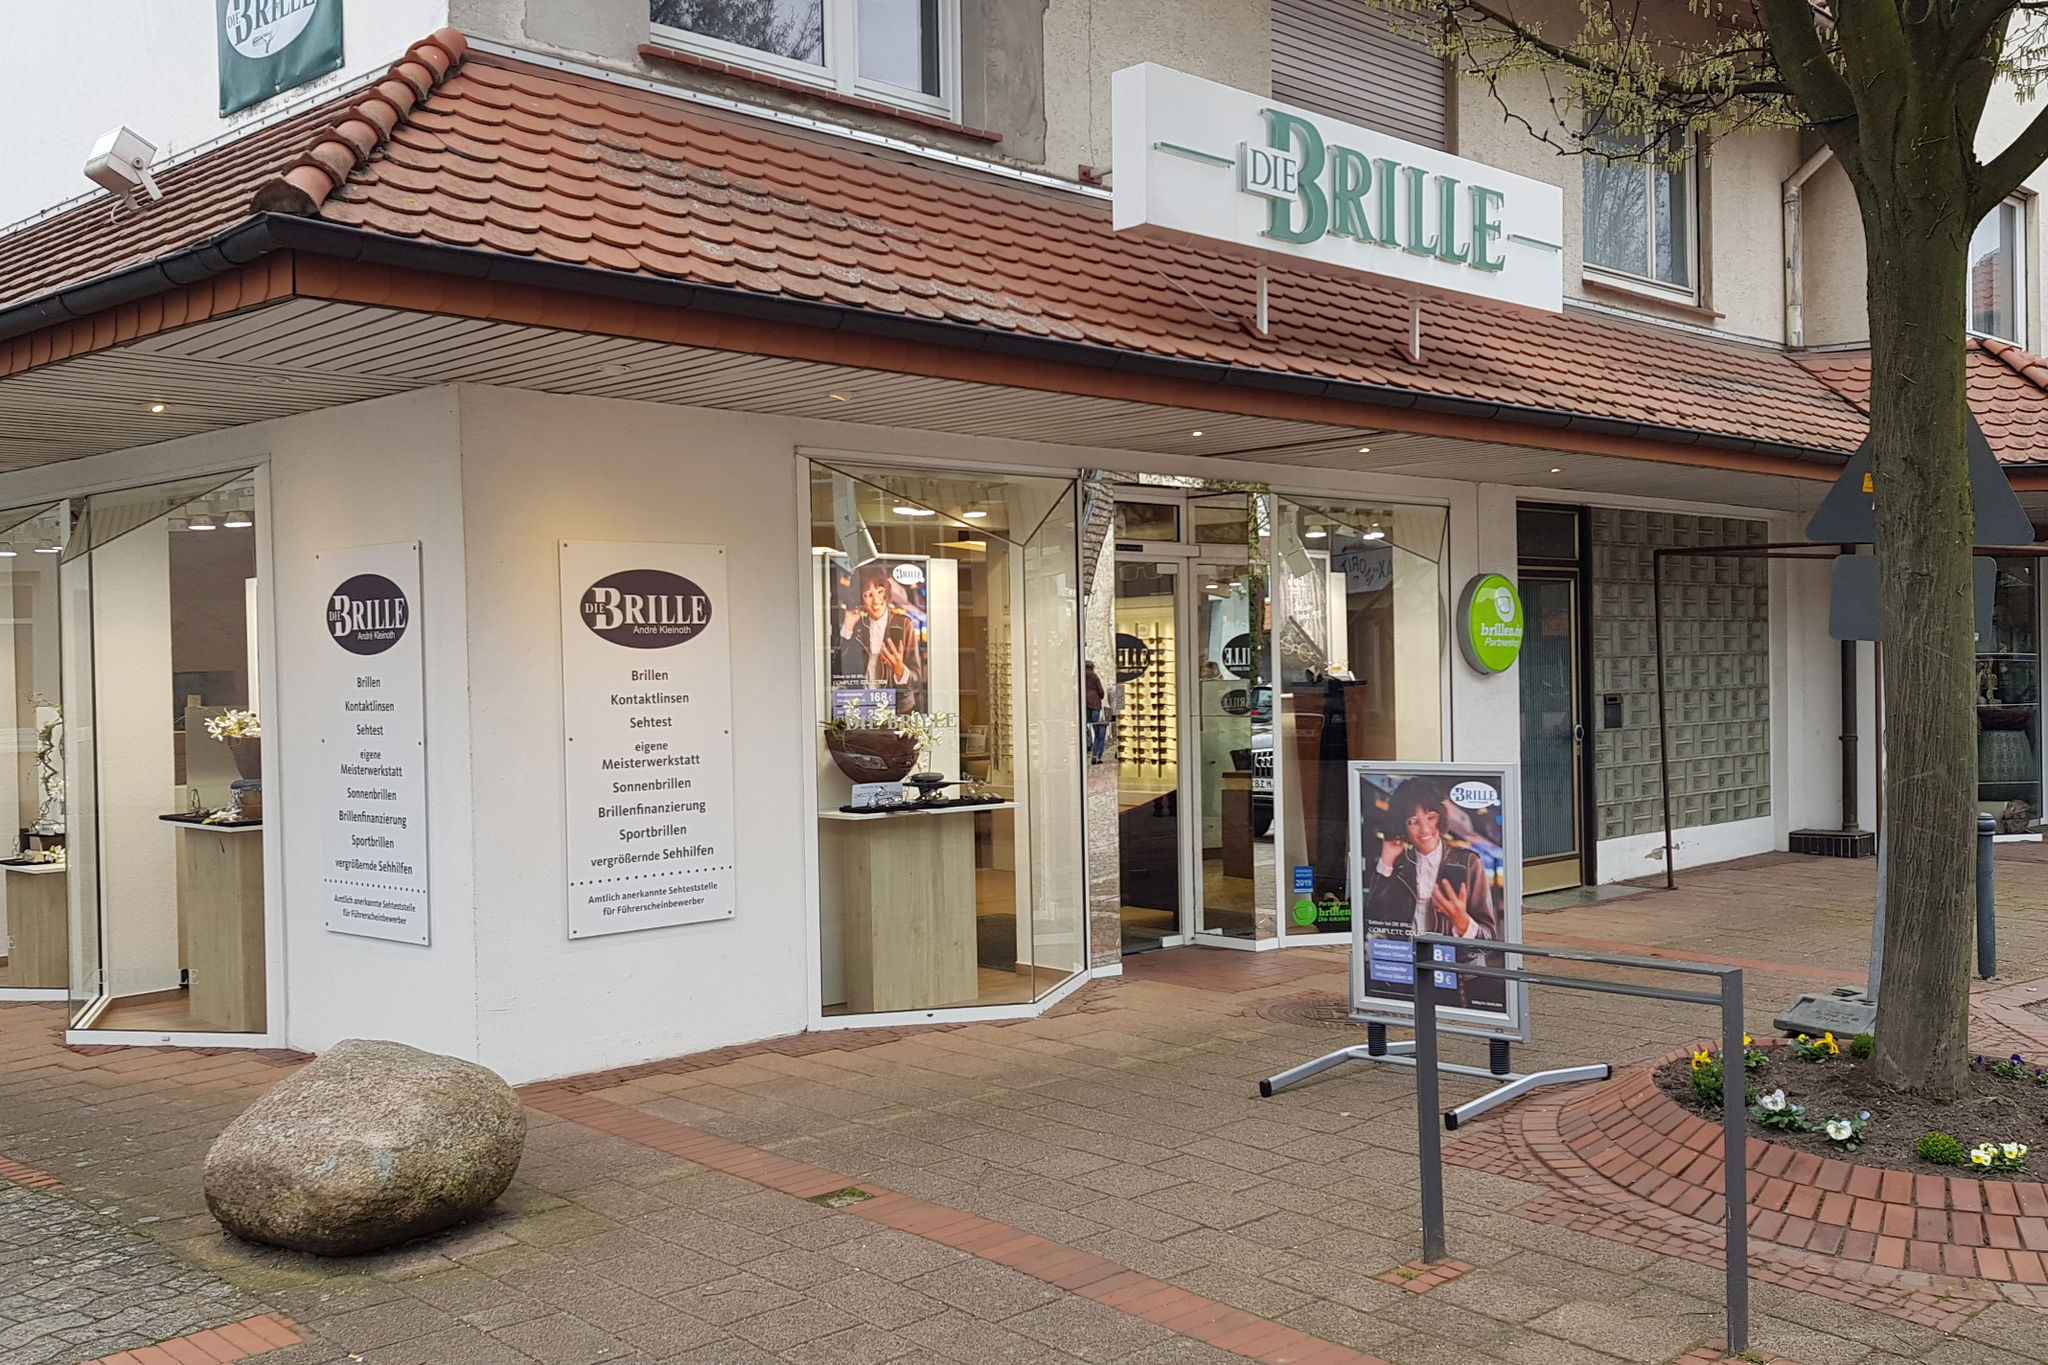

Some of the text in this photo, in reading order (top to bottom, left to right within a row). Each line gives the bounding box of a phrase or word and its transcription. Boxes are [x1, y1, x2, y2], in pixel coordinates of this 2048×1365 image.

[228, 11, 241, 29] DIE
[1250, 107, 1506, 272] DIE BRILLE
[329, 594, 406, 637] DIE BRILLE
[585, 587, 707, 630] DIE BRILLE
[357, 630, 396, 641] André Kleinoth
[633, 625, 692, 635] André Kleinoth
[357, 677, 381, 688] Brillen
[631, 669, 669, 681] Brillen
[610, 693, 690, 706] Kontaktlinsen
[870, 691, 888, 702] 168
[345, 700, 395, 712] Kontaktlinsen
[356, 724, 384, 736] Sehtest
[630, 717, 673, 729] Sehtest
[635, 741, 669, 754] eigene
[359, 749, 382, 762] eigene
[601, 754, 701, 770] Meisterwerkstatt
[340, 764, 403, 777] Meisterwerkstatt
[612, 777, 692, 793] Sonnenbrillen
[347, 787, 397, 801] Sonnenbrillen
[1455, 787, 1496, 801] BRILLE
[598, 801, 706, 818] Brillenfinanzierung
[338, 809, 407, 829] Brillenfinanzierung
[619, 824, 687, 843] Sportbrillen
[351, 834, 395, 849] Sportbrillen
[590, 845, 714, 868] vergrößernde Sehhilfen
[334, 858, 413, 875] vergrößernde Sehhilfen
[588, 881, 718, 904] Amtlich anerkannte Sehteststelle
[334, 894, 416, 913] Amtlich anerkannte Sehteststelle
[603, 897, 705, 916] für Führerscheinbewerber
[342, 908, 407, 925] für Führerscheinbewerber
